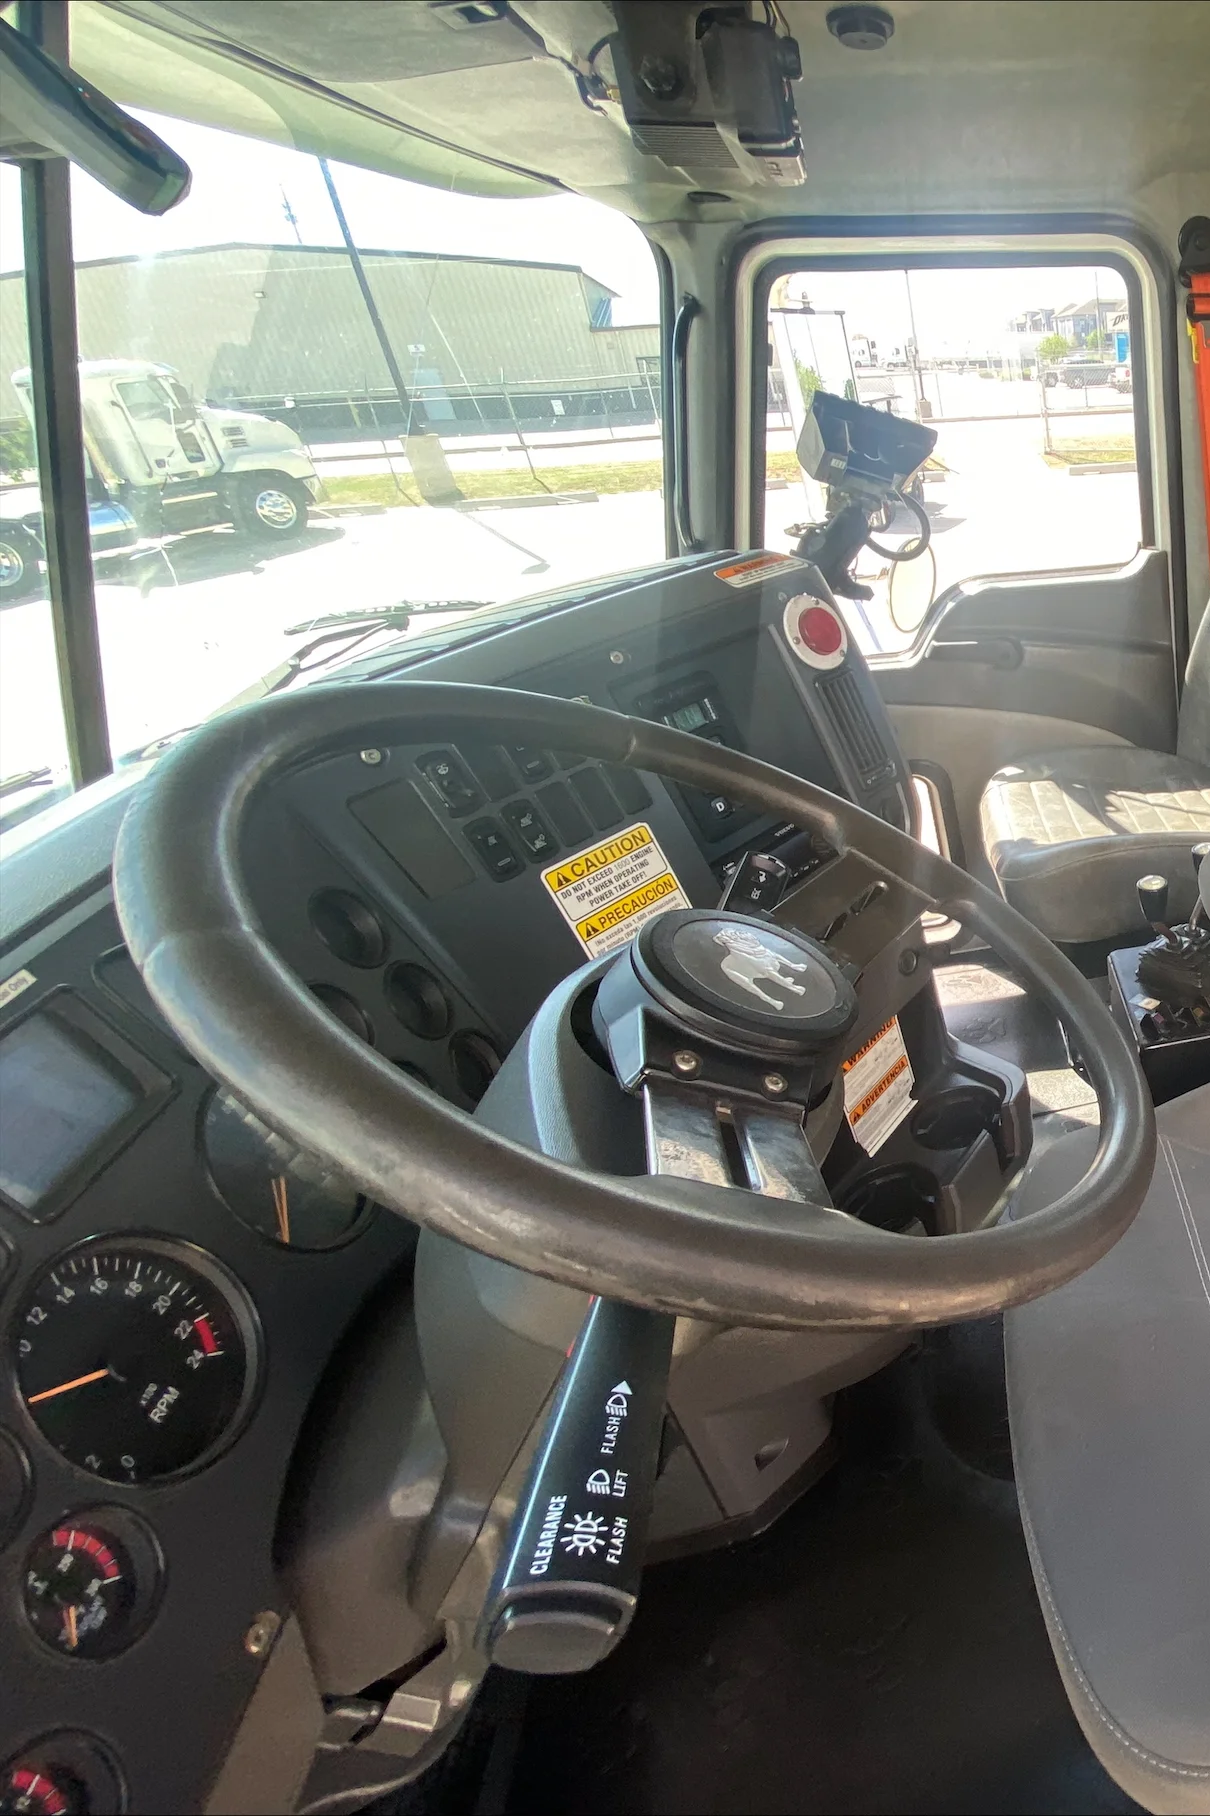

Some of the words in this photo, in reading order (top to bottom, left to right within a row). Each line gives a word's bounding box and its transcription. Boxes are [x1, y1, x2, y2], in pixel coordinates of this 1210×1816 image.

[715, 801, 725, 813] D
[571, 830, 646, 877] CAUTION
[560, 887, 572, 899] DO
[572, 880, 587, 893] NOT
[587, 867, 613, 884] EXCEED
[614, 859, 631, 872] 1600
[630, 847, 653, 862] ENGINE
[576, 889, 593, 903] RPM
[593, 879, 614, 895] WHEN
[613, 859, 650, 884] OPERATING
[589, 891, 614, 907] POWER
[614, 881, 632, 895] TAKE
[632, 872, 647, 884] OFF!
[599, 878, 673, 928] PRECAUCIÓN
[647, 896, 677, 916] revoluciones
[861, 1062, 905, 1112] ADVERTENCIA
[55, 1286, 76, 1304] 14
[90, 1277, 109, 1295] 16
[124, 1280, 143, 1298] 18
[26, 1306, 48, 1326] 12
[152, 1294, 172, 1316] 20
[173, 1319, 194, 1341] 22
[186, 1348, 207, 1370] 24
[149, 1385, 180, 1424] RPM
[600, 1416, 621, 1454] FLASH
[120, 1454, 136, 1468] 0
[612, 1469, 629, 1498] LIFT
[530, 1493, 567, 1576] CLEARANCE
[606, 1516, 628, 1564] FLASH
